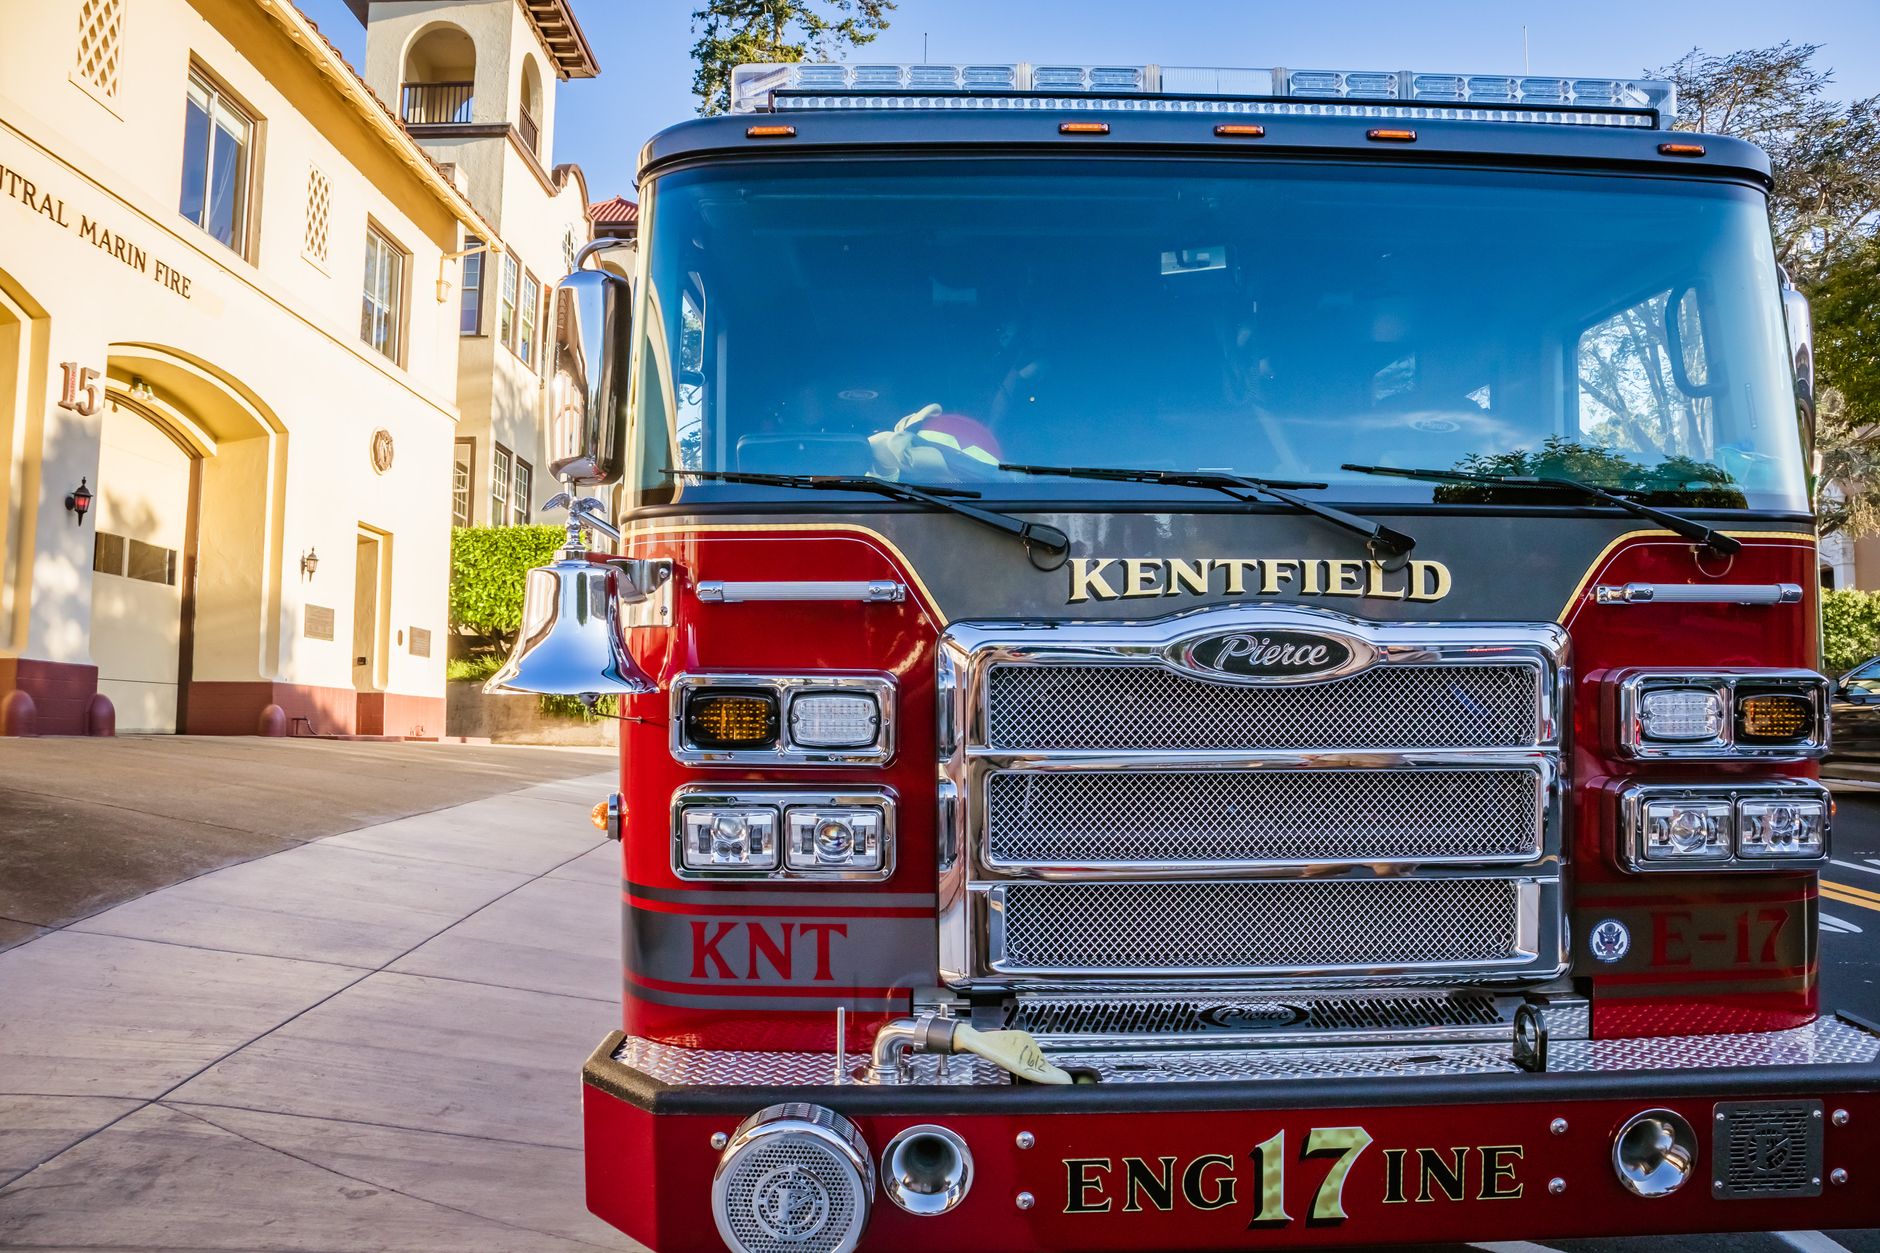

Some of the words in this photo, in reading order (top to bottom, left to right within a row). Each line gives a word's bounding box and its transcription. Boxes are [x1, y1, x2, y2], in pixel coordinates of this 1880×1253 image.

[79, 214, 146, 274] MARIN
[154, 259, 191, 300] FIRE
[57, 361, 101, 417] 15
[1066, 557, 1453, 604] KENTFIELD
[1213, 634, 1331, 671] Pierce
[689, 921, 848, 981] KNT
[1651, 908, 1791, 968] E-17
[1219, 1007, 1290, 1022] Pierce
[1062, 1153, 1238, 1214] ENG
[1248, 1126, 1374, 1229] 17
[1382, 1144, 1525, 1204] INE
